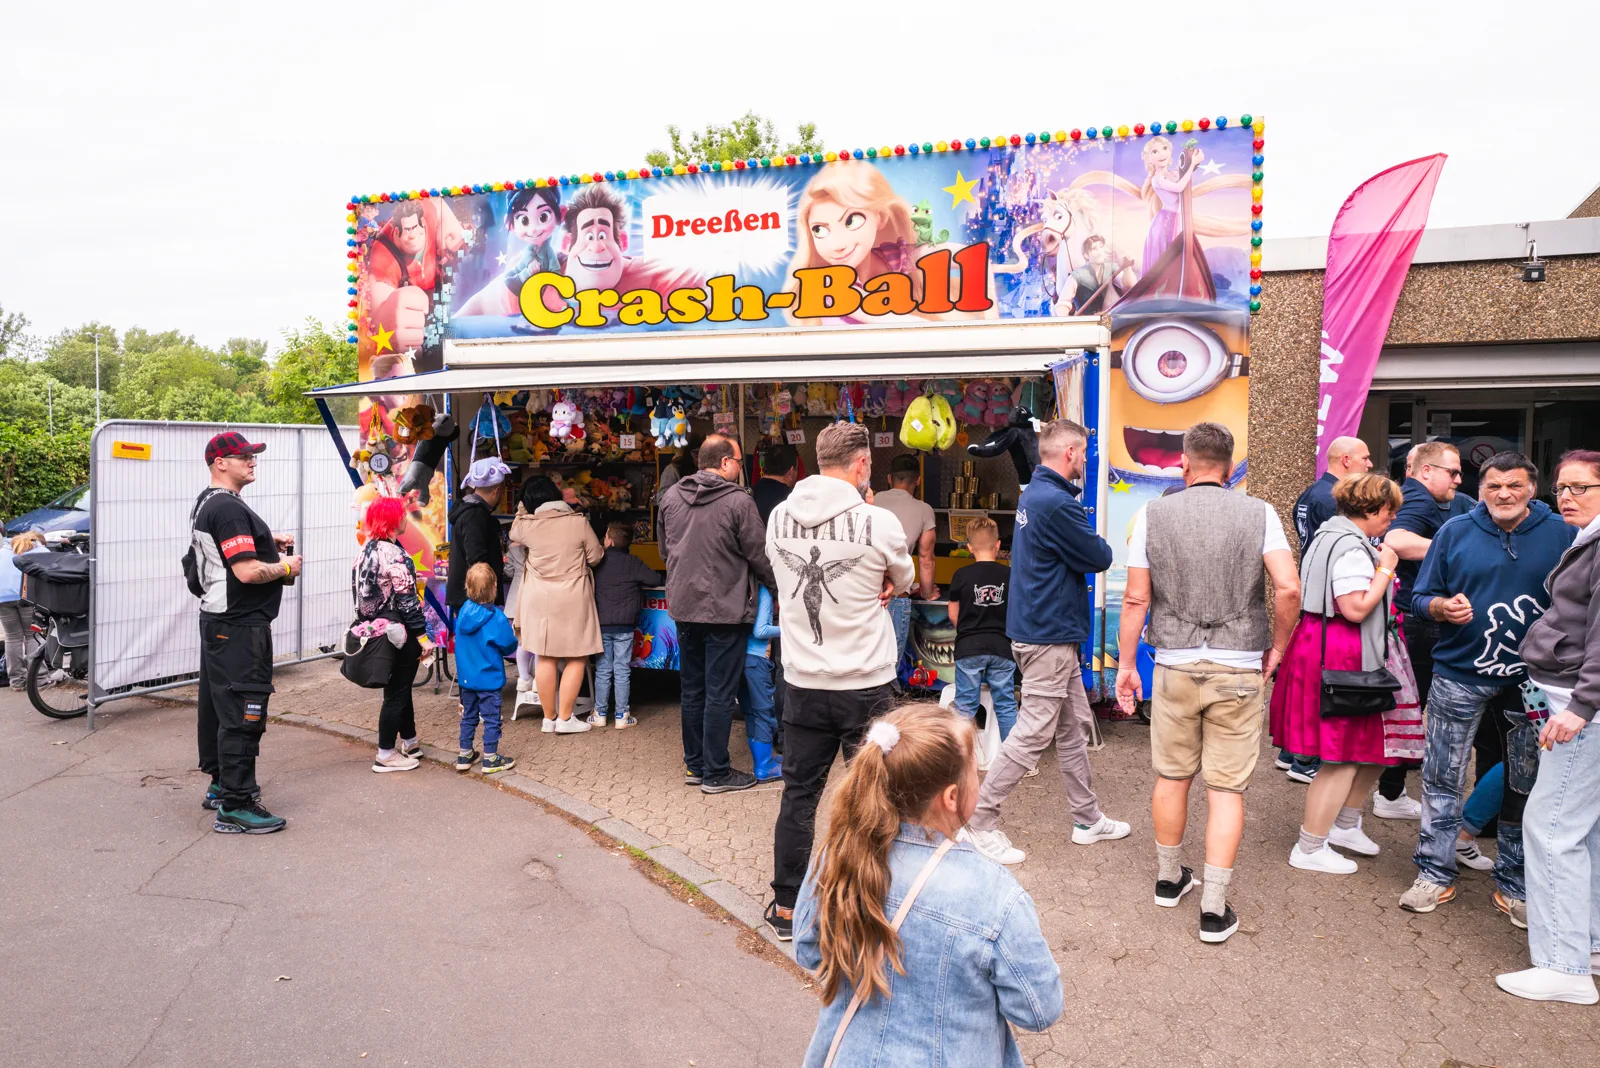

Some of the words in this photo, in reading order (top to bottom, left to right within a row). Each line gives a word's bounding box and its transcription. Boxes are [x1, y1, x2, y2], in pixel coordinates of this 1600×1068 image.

[651, 209, 781, 238] Dreeßen
[519, 242, 993, 329] Crash-Ball
[790, 433, 802, 442] 20
[878, 436, 890, 445] 30
[623, 438, 633, 447] 15
